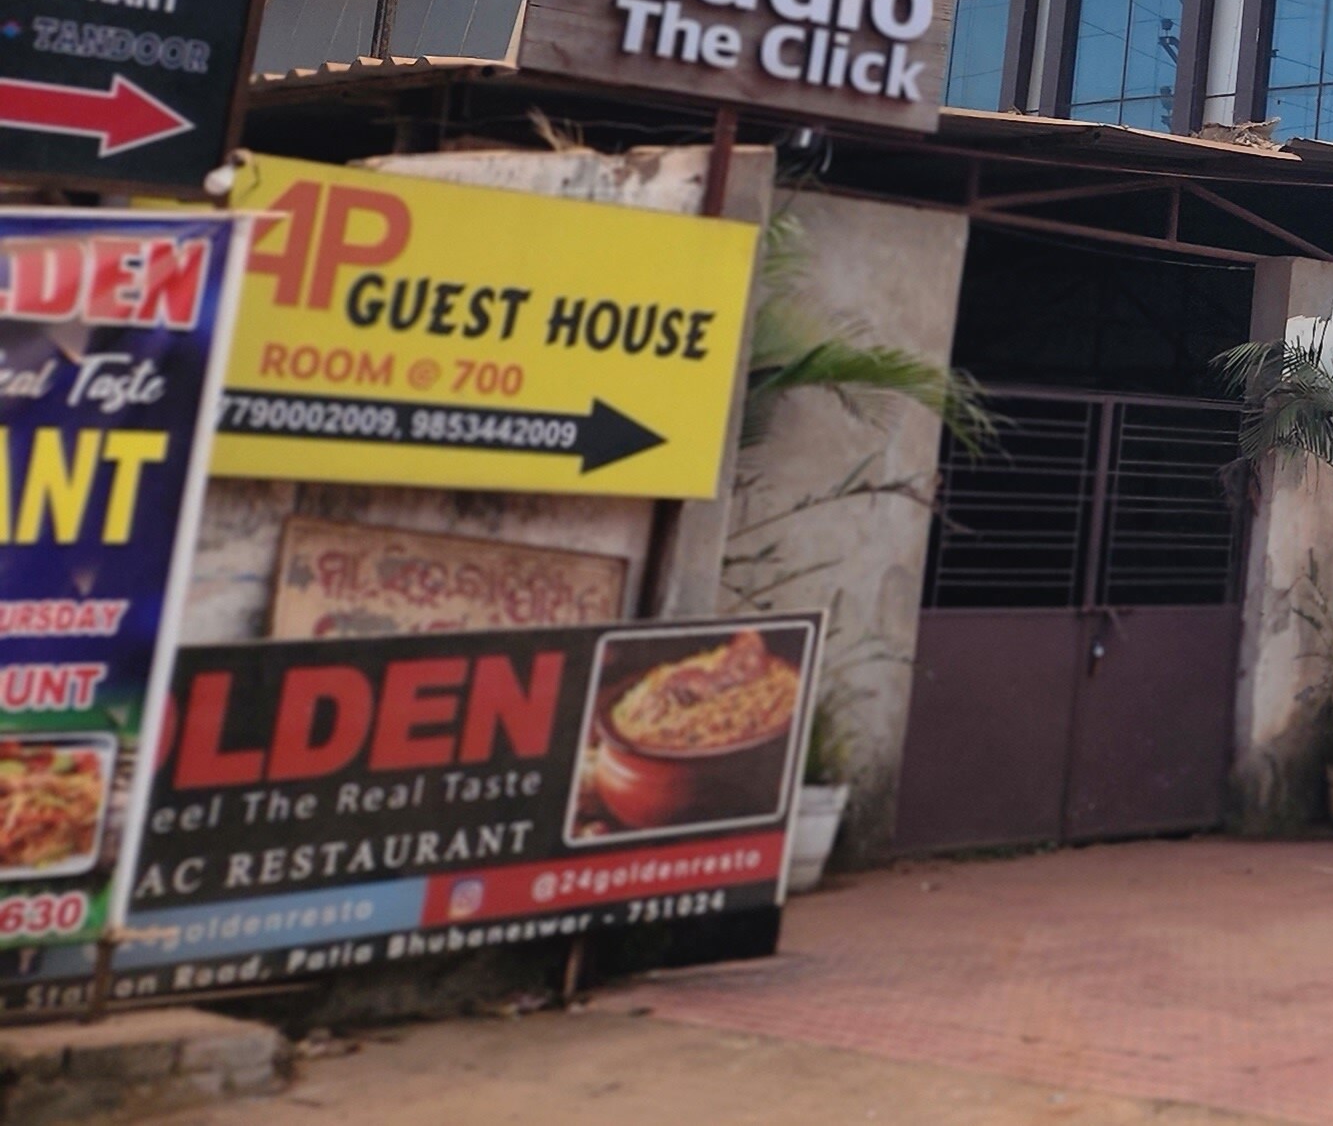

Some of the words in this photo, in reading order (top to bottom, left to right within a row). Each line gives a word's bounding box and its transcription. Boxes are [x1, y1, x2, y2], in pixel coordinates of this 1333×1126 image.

[33, 16, 210, 73] TANDOOR
[760, 23, 927, 103] Click
[0, 234, 210, 331] DEN
[245, 179, 412, 311] AP
[345, 272, 531, 341] GUEST
[545, 296, 716, 361] HOUSE
[0, 348, 57, 398] eal
[67, 352, 166, 414] Taste
[259, 342, 396, 387] ROOM
[407, 358, 442, 391] @
[451, 360, 525, 397] 700
[411, 410, 577, 448] 9853442009
[154, 650, 566, 790] LDEN
[244, 790, 317, 826] The
[336, 775, 425, 816] Real
[443, 769, 543, 803] Taste
[134, 856, 207, 900] AC
[225, 820, 534, 889] RESTAURANT
[531, 848, 761, 902] @24goldenresto
[173, 954, 272, 991] Road,
[286, 937, 373, 973] Patia
[386, 909, 591, 960] Bhubaneswar
[627, 890, 725, 923] 751024
